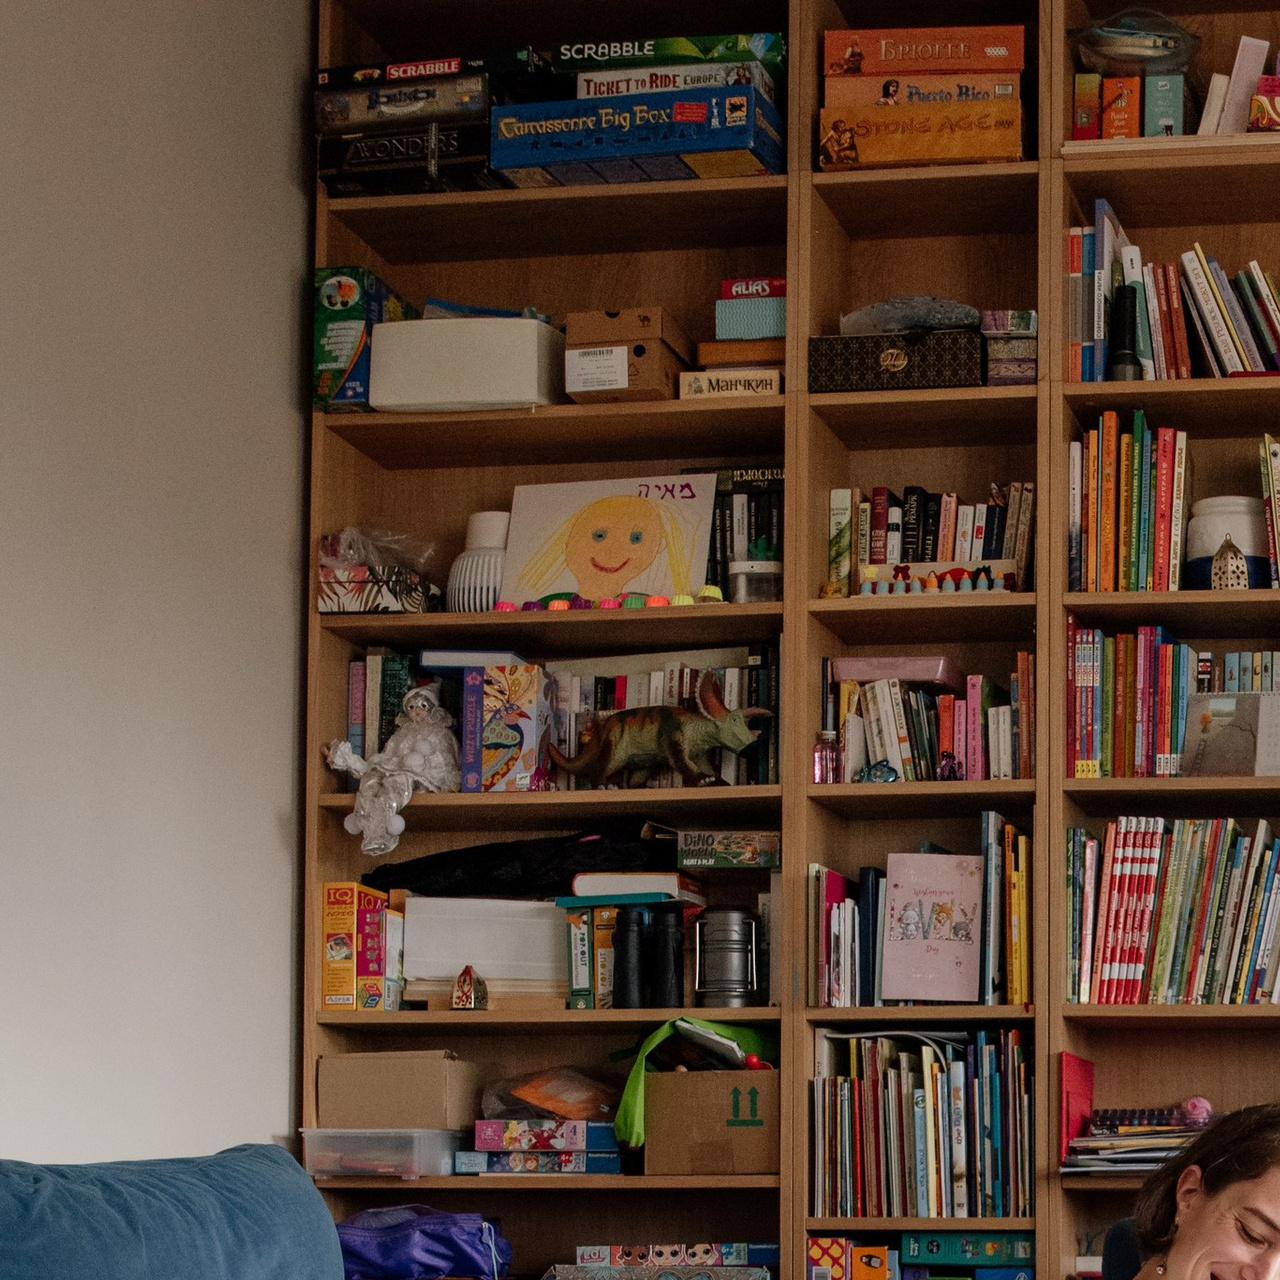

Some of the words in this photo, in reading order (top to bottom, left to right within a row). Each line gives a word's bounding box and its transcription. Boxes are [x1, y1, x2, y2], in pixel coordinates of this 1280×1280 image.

[559, 40, 655, 61] SCRABBLE
[388, 60, 460, 80] SCRABBLE
[583, 78, 633, 97] TICKET
[634, 78, 647, 90] TO
[649, 73, 681, 90] RIDE
[683, 72, 720, 87] EUROPE
[907, 84, 953, 104] Puerto
[956, 83, 990, 102] Rico
[498, 116, 597, 140] Carcassonne
[598, 106, 631, 132] Big
[632, 104, 671, 125] Box
[855, 117, 932, 137] STONE
[936, 113, 993, 134] AGE
[731, 279, 771, 297] ALIAS
[706, 377, 774, 394] Манчкин
[637, 482, 697, 500] מאיה
[909, 494, 918, 524] РЕМАРК
[1158, 522, 1166, 563] СЕЛЬМА
[328, 888, 354, 904] IQ
[359, 892, 375, 910] IQ
[569, 1124, 577, 1136] 4
